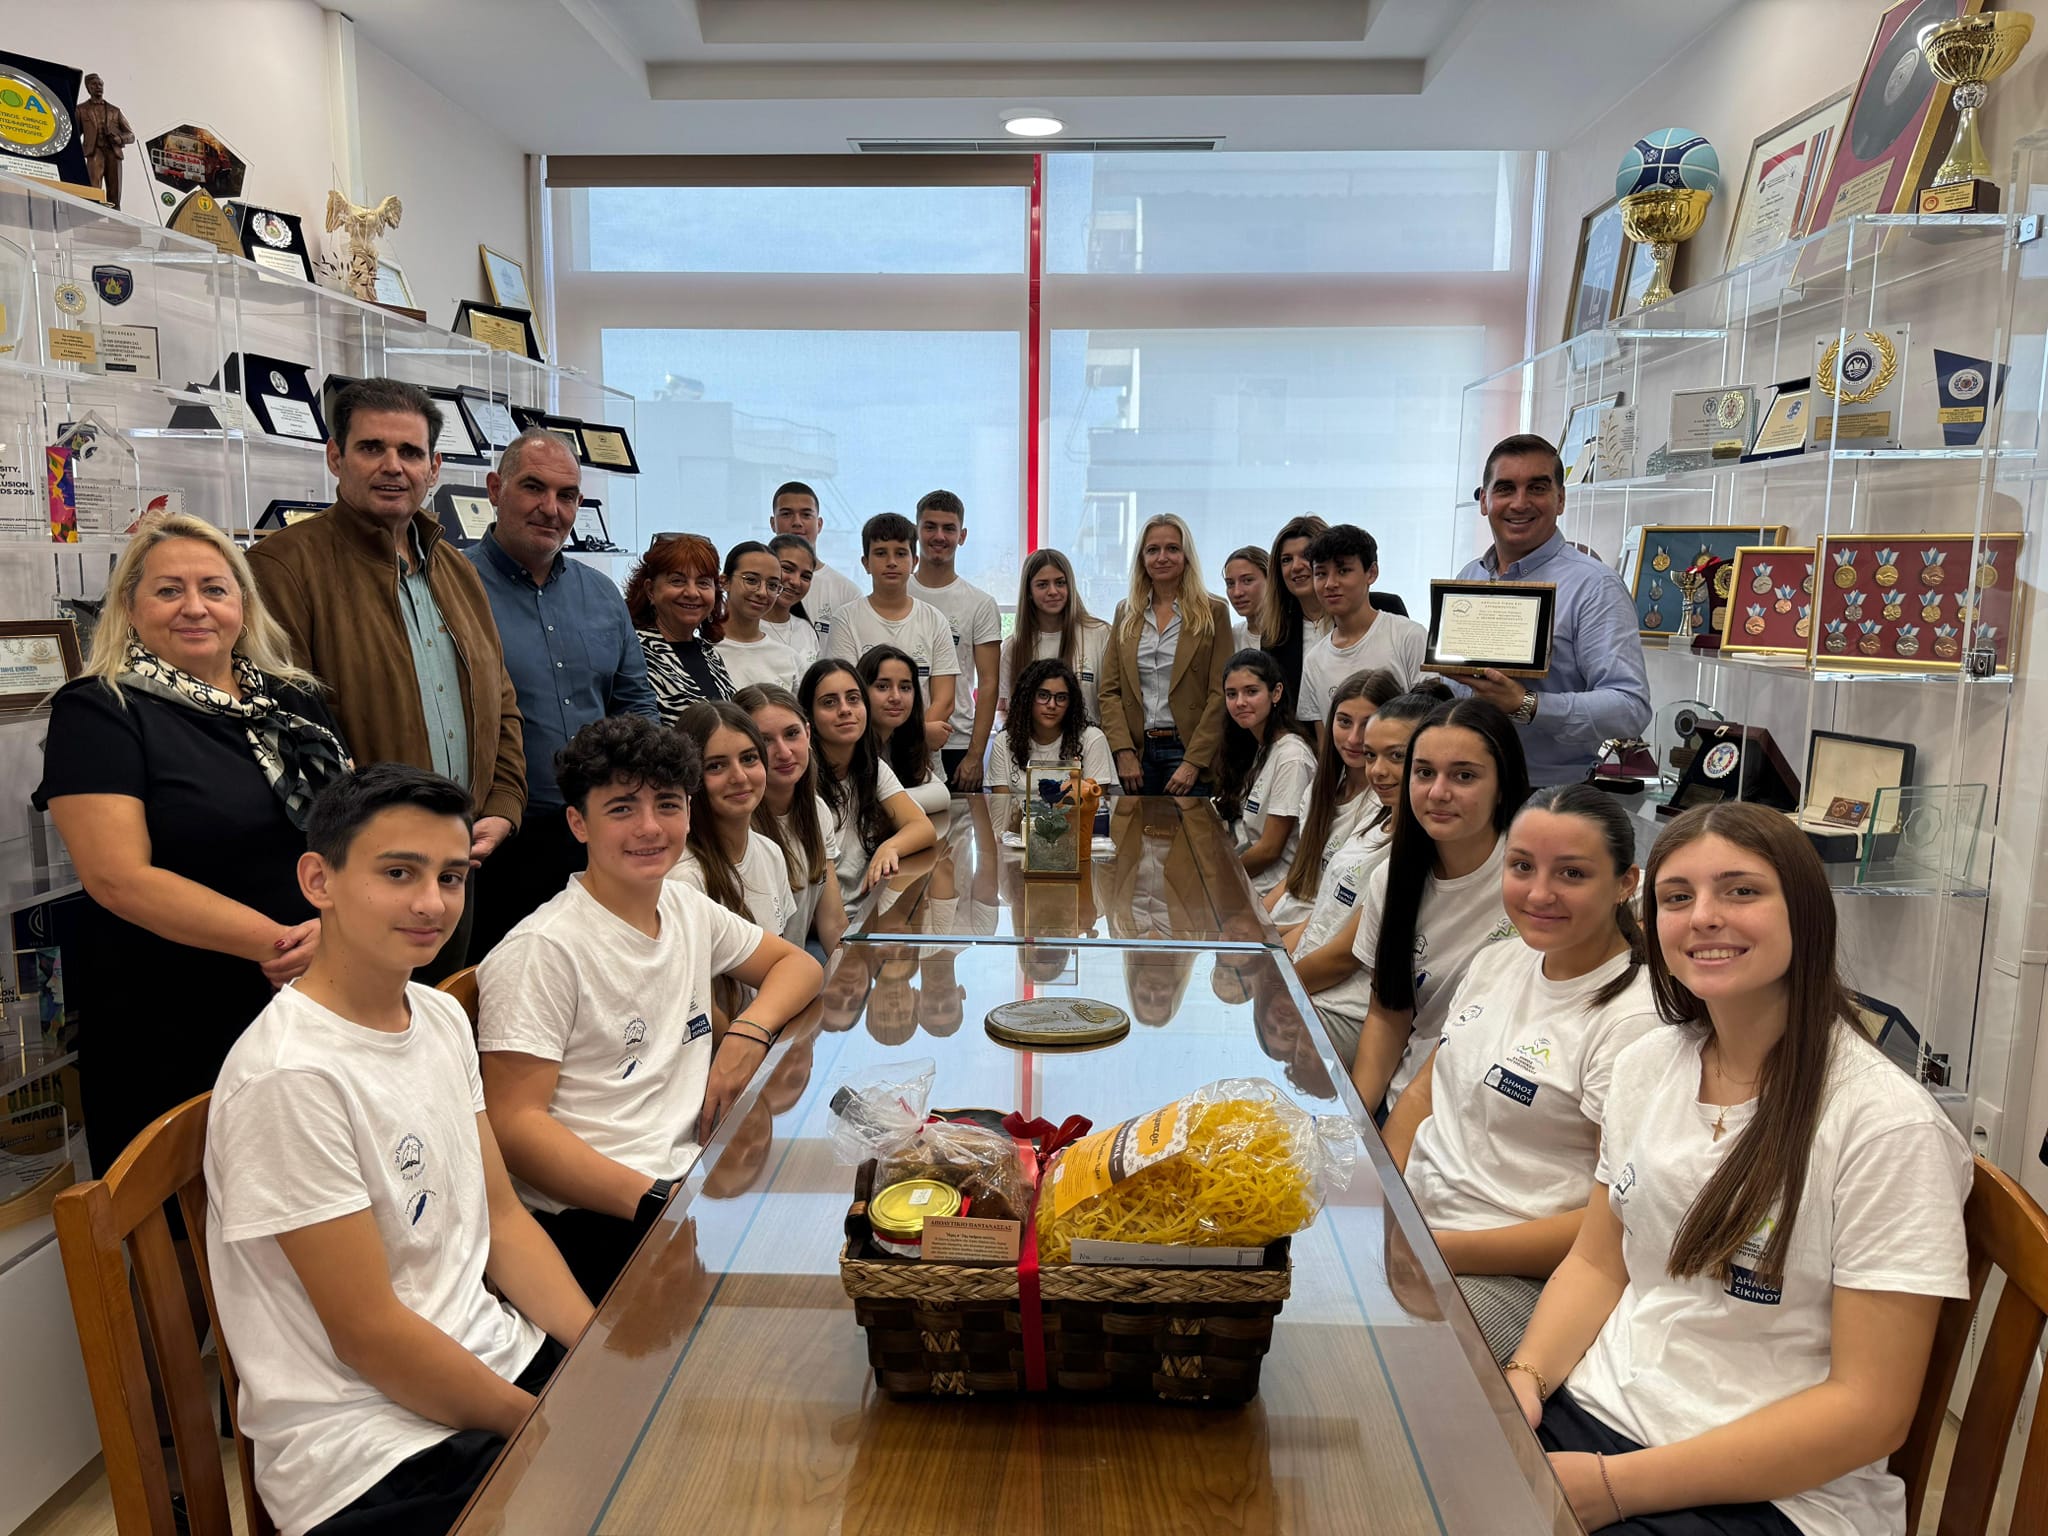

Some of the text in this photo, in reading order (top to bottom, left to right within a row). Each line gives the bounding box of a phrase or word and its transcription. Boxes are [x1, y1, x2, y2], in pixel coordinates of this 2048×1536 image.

[1499, 1084, 1533, 1104] ΣΙΚΙΝΟΥ
[1503, 1077, 1533, 1096] ΔΗΜΟΣ
[968, 1223, 1013, 1232] ΠΑΝΤΑΝΑΣΣΑΣ
[1734, 1286, 1780, 1301] ΣΙΚΙΝΟΥ
